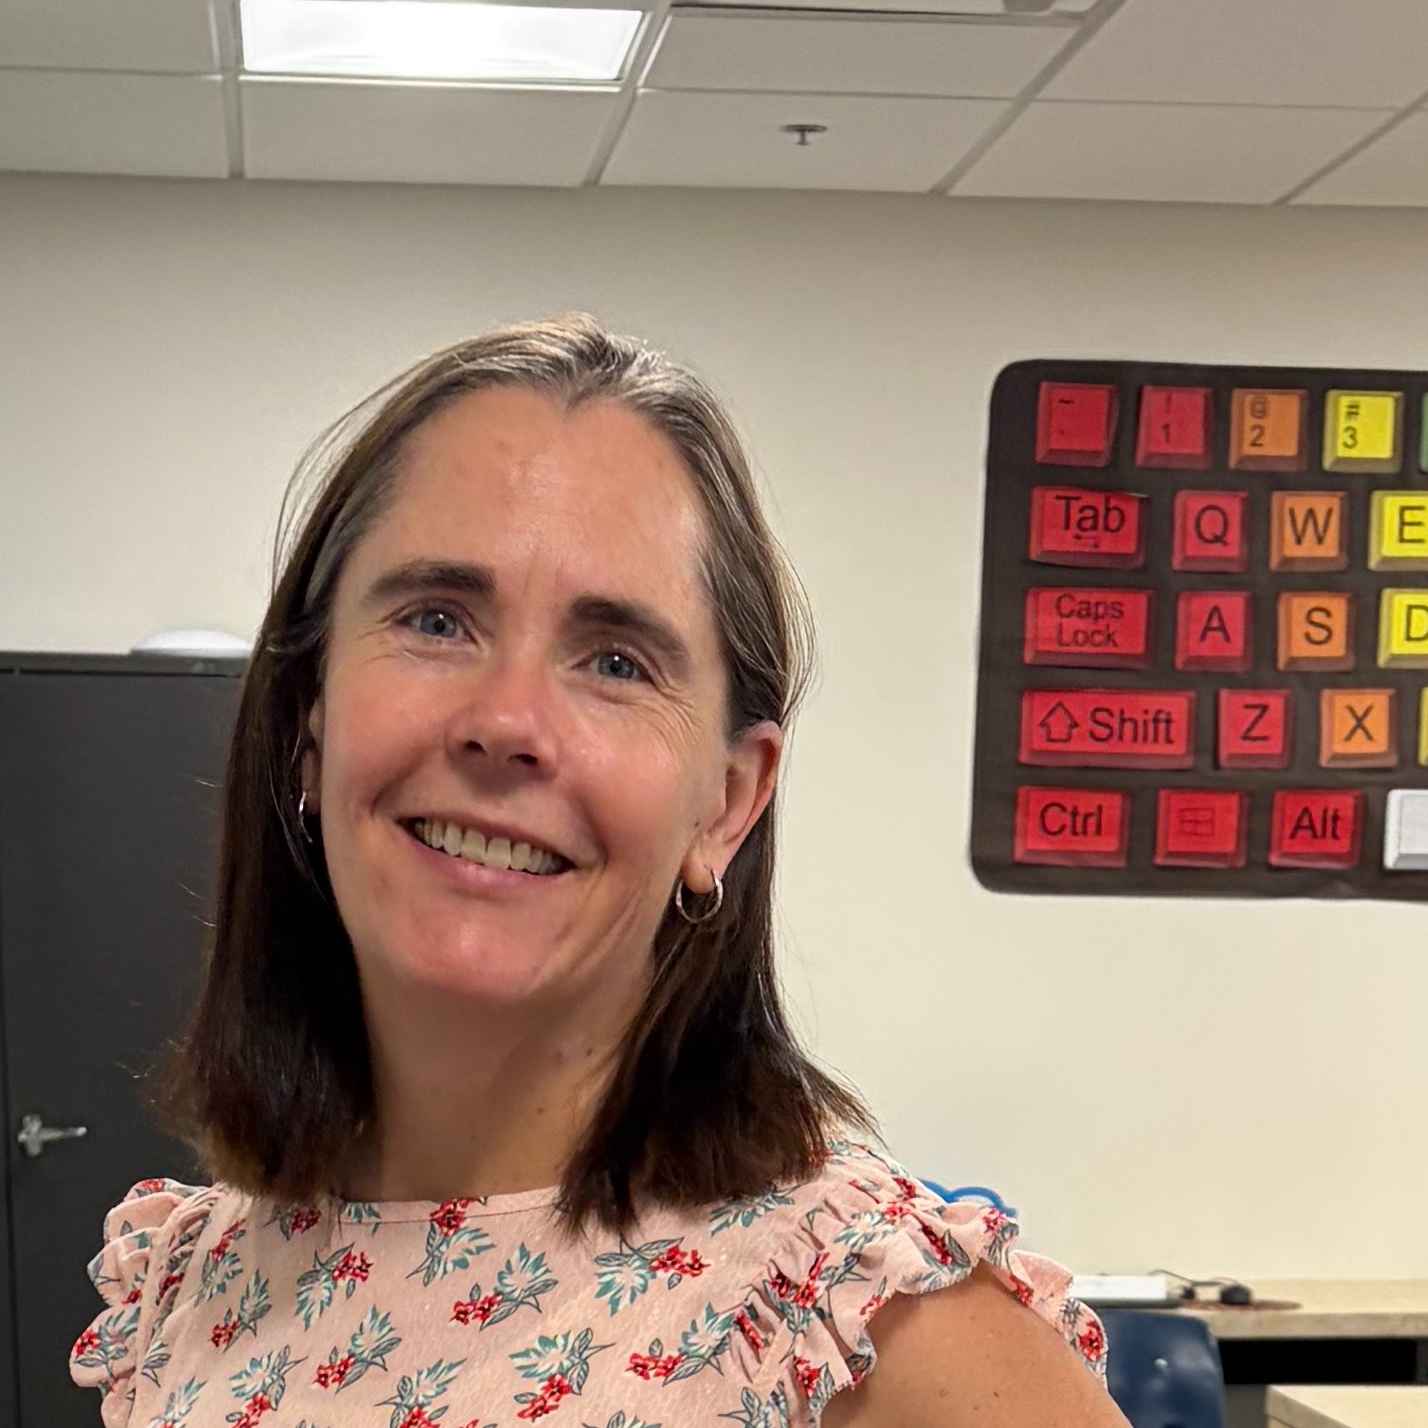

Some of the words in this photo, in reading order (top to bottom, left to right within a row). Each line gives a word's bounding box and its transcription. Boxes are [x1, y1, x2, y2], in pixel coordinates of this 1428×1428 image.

[1161, 423, 1171, 443] 1
[1249, 425, 1265, 447] 2
[1341, 426, 1358, 449] 3
[1056, 496, 1126, 535] Tab
[1194, 505, 1229, 546] Q
[1287, 508, 1334, 544] W
[1398, 506, 1425, 543] E
[1055, 595, 1125, 625] Caps
[1199, 605, 1230, 642] A
[1305, 607, 1333, 646] S
[1056, 625, 1118, 649] Lock
[1089, 707, 1173, 744] Shift
[1240, 704, 1269, 742] Z
[1344, 705, 1373, 742] X
[1039, 802, 1102, 837] Ctrl
[1290, 807, 1340, 840] Alt
